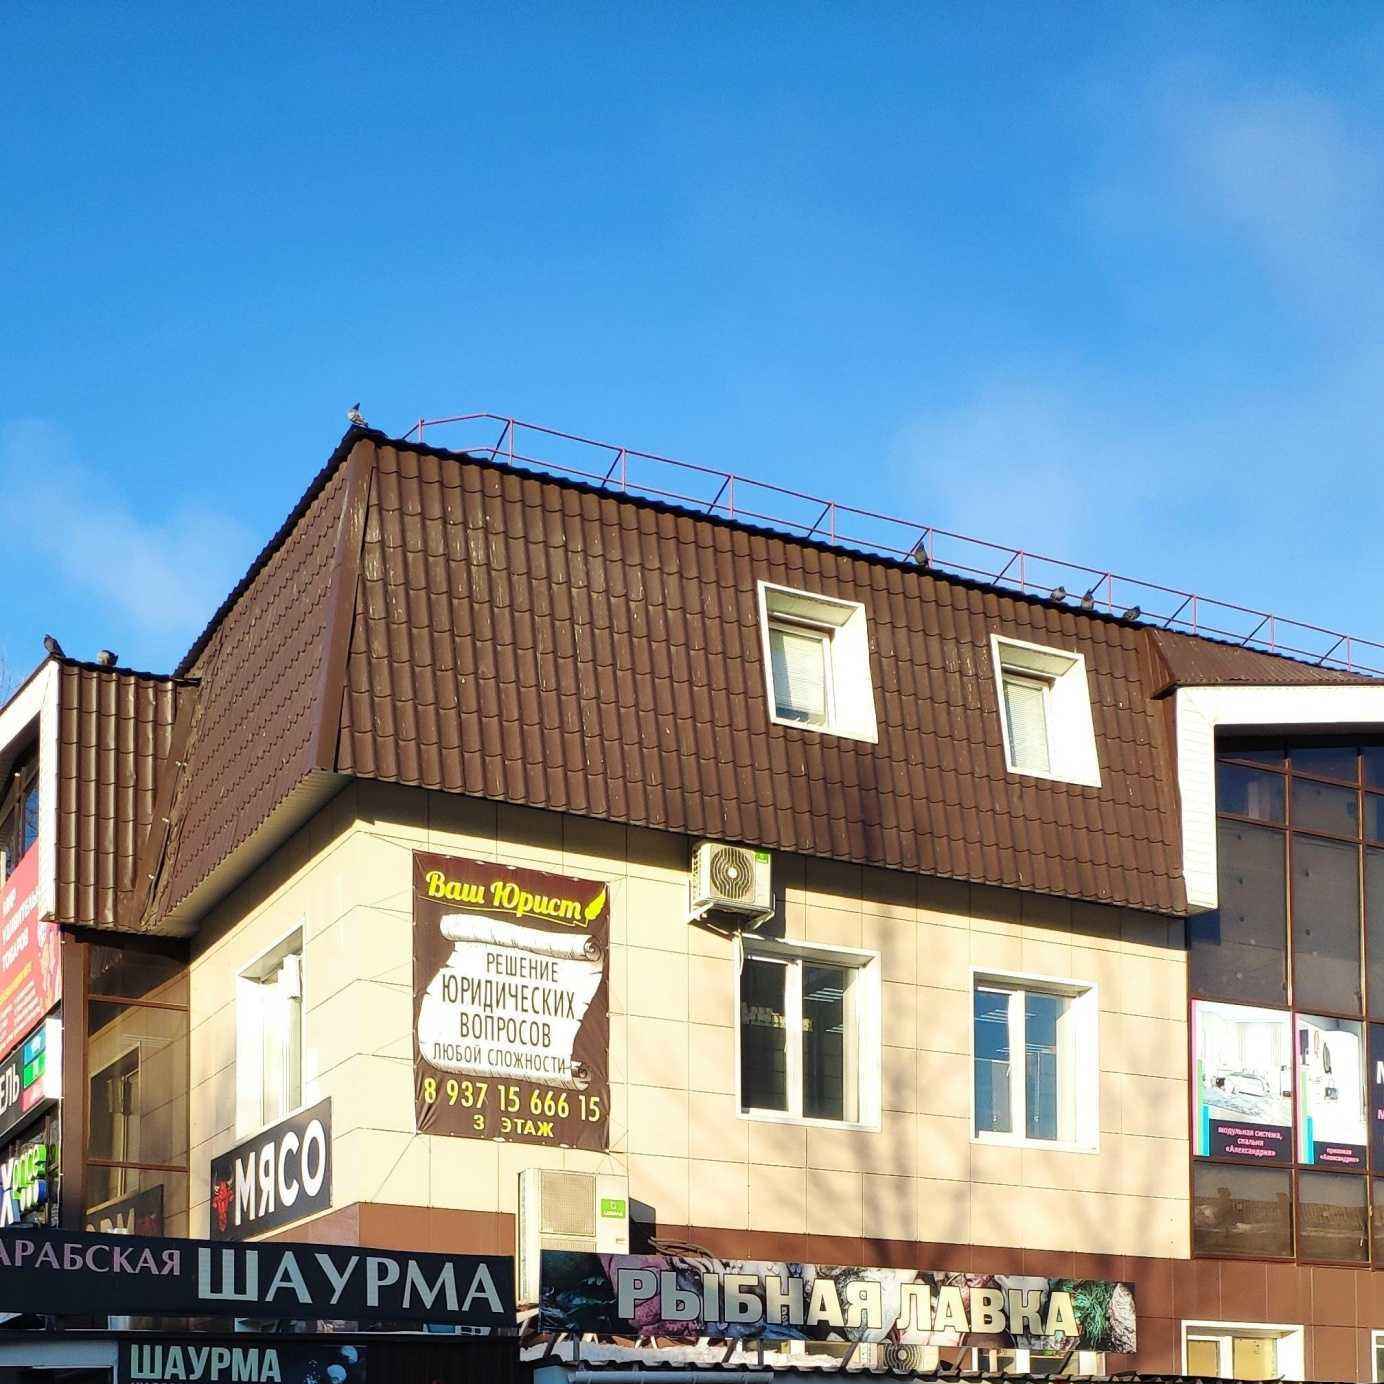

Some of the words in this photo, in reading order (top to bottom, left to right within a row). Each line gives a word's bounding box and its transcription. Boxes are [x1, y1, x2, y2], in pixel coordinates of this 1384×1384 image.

[426, 871, 485, 904] Ваш
[491, 881, 582, 918] Юрист
[486, 952, 559, 982] РЕШЕНИЕ
[442, 974, 575, 1019] ЮРИДИЧЕСКИХ
[460, 1012, 551, 1048] ВОПРОСОВ
[433, 1042, 481, 1065] ЛЮБОЙ
[488, 1048, 567, 1074] СЛОЖНОСТИ
[424, 1077, 437, 1104] 8
[446, 1080, 489, 1109] 937
[499, 1085, 520, 1113] 15
[530, 1089, 570, 1119] 666
[578, 1095, 600, 1122] 15
[473, 1115, 485, 1131] 3
[501, 1118, 554, 1137] ЭТАЖ
[235, 1119, 326, 1226] МЯСО
[198, 1247, 504, 1313] ШАУРМА
[617, 1267, 882, 1330] РЫБНАЯ
[897, 1282, 1077, 1338] ЛАВКА
[131, 1344, 281, 1382] ШАУРМА
